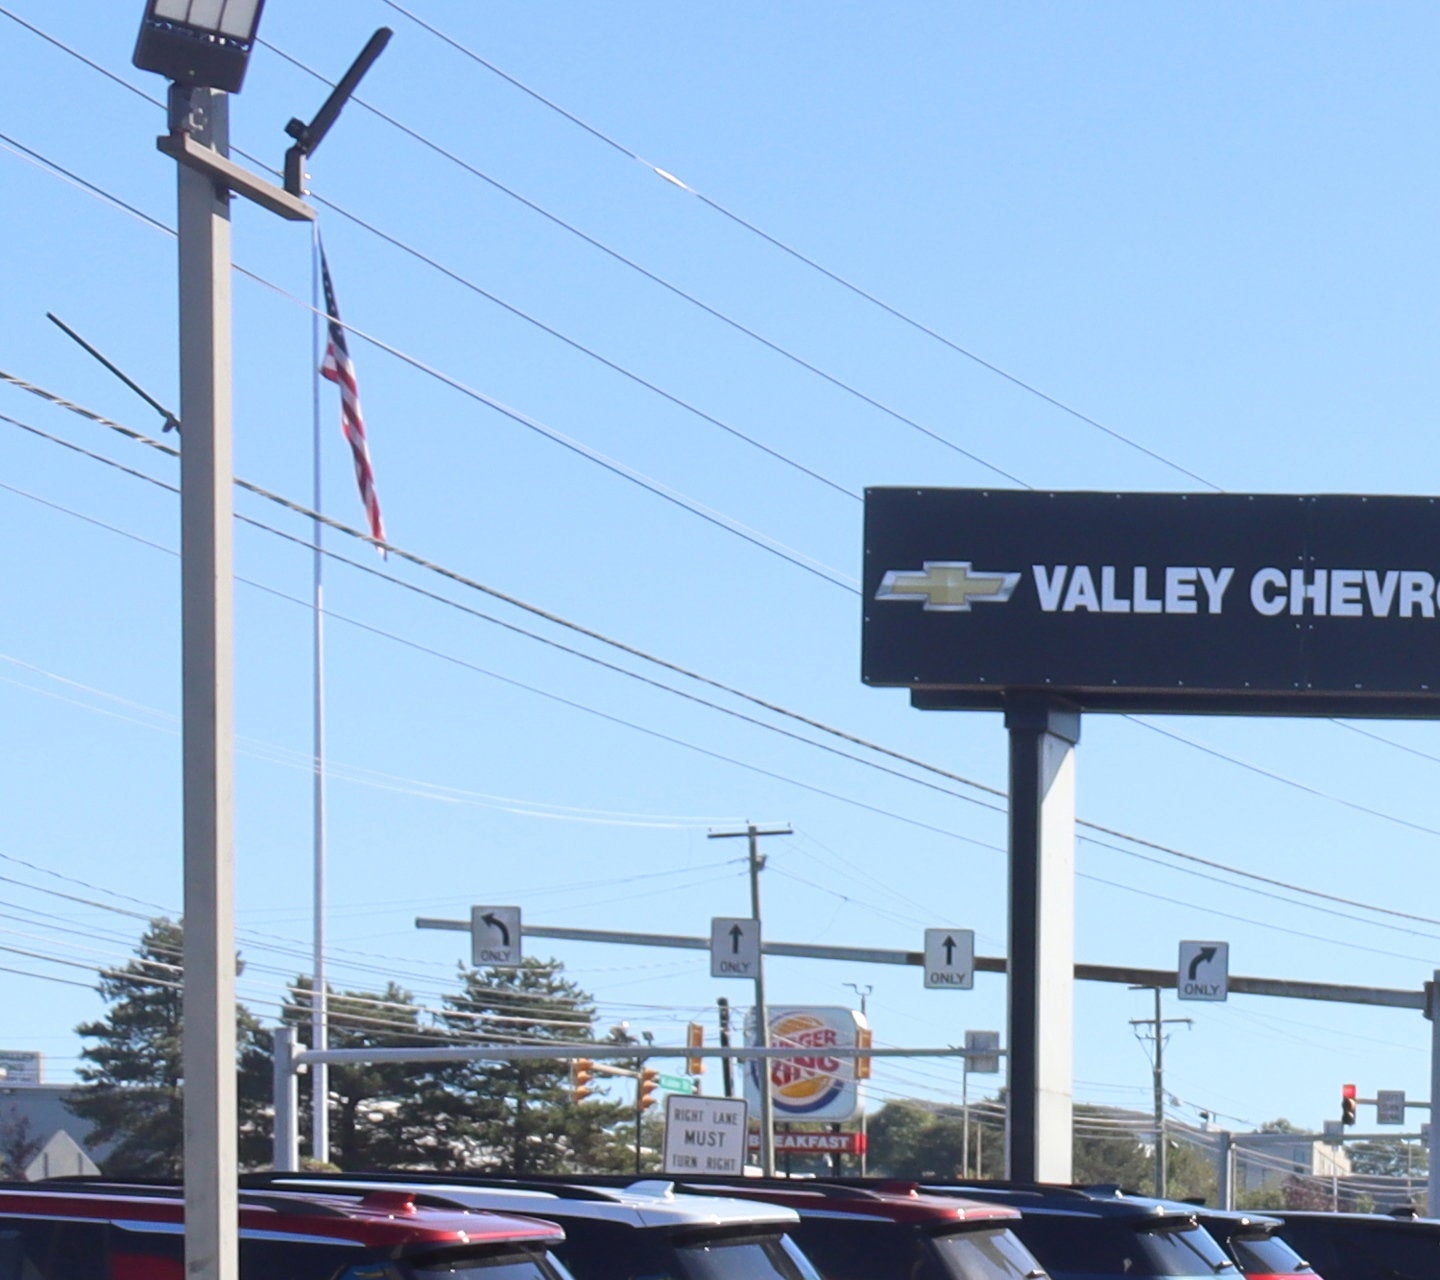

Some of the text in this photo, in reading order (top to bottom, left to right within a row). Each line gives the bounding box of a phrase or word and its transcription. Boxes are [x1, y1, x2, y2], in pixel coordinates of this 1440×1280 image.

[1032, 565, 1234, 614] VALLEY
[481, 950, 511, 962] ONLY
[720, 960, 750, 973] ONLY
[930, 972, 966, 985] ONLY
[1184, 983, 1221, 996] ONLY
[674, 1108, 738, 1125] RIGHT LANE
[684, 1130, 726, 1148] MUST
[748, 1135, 850, 1149] BEAKFAST
[673, 1153, 736, 1171] TURN RIGHT
